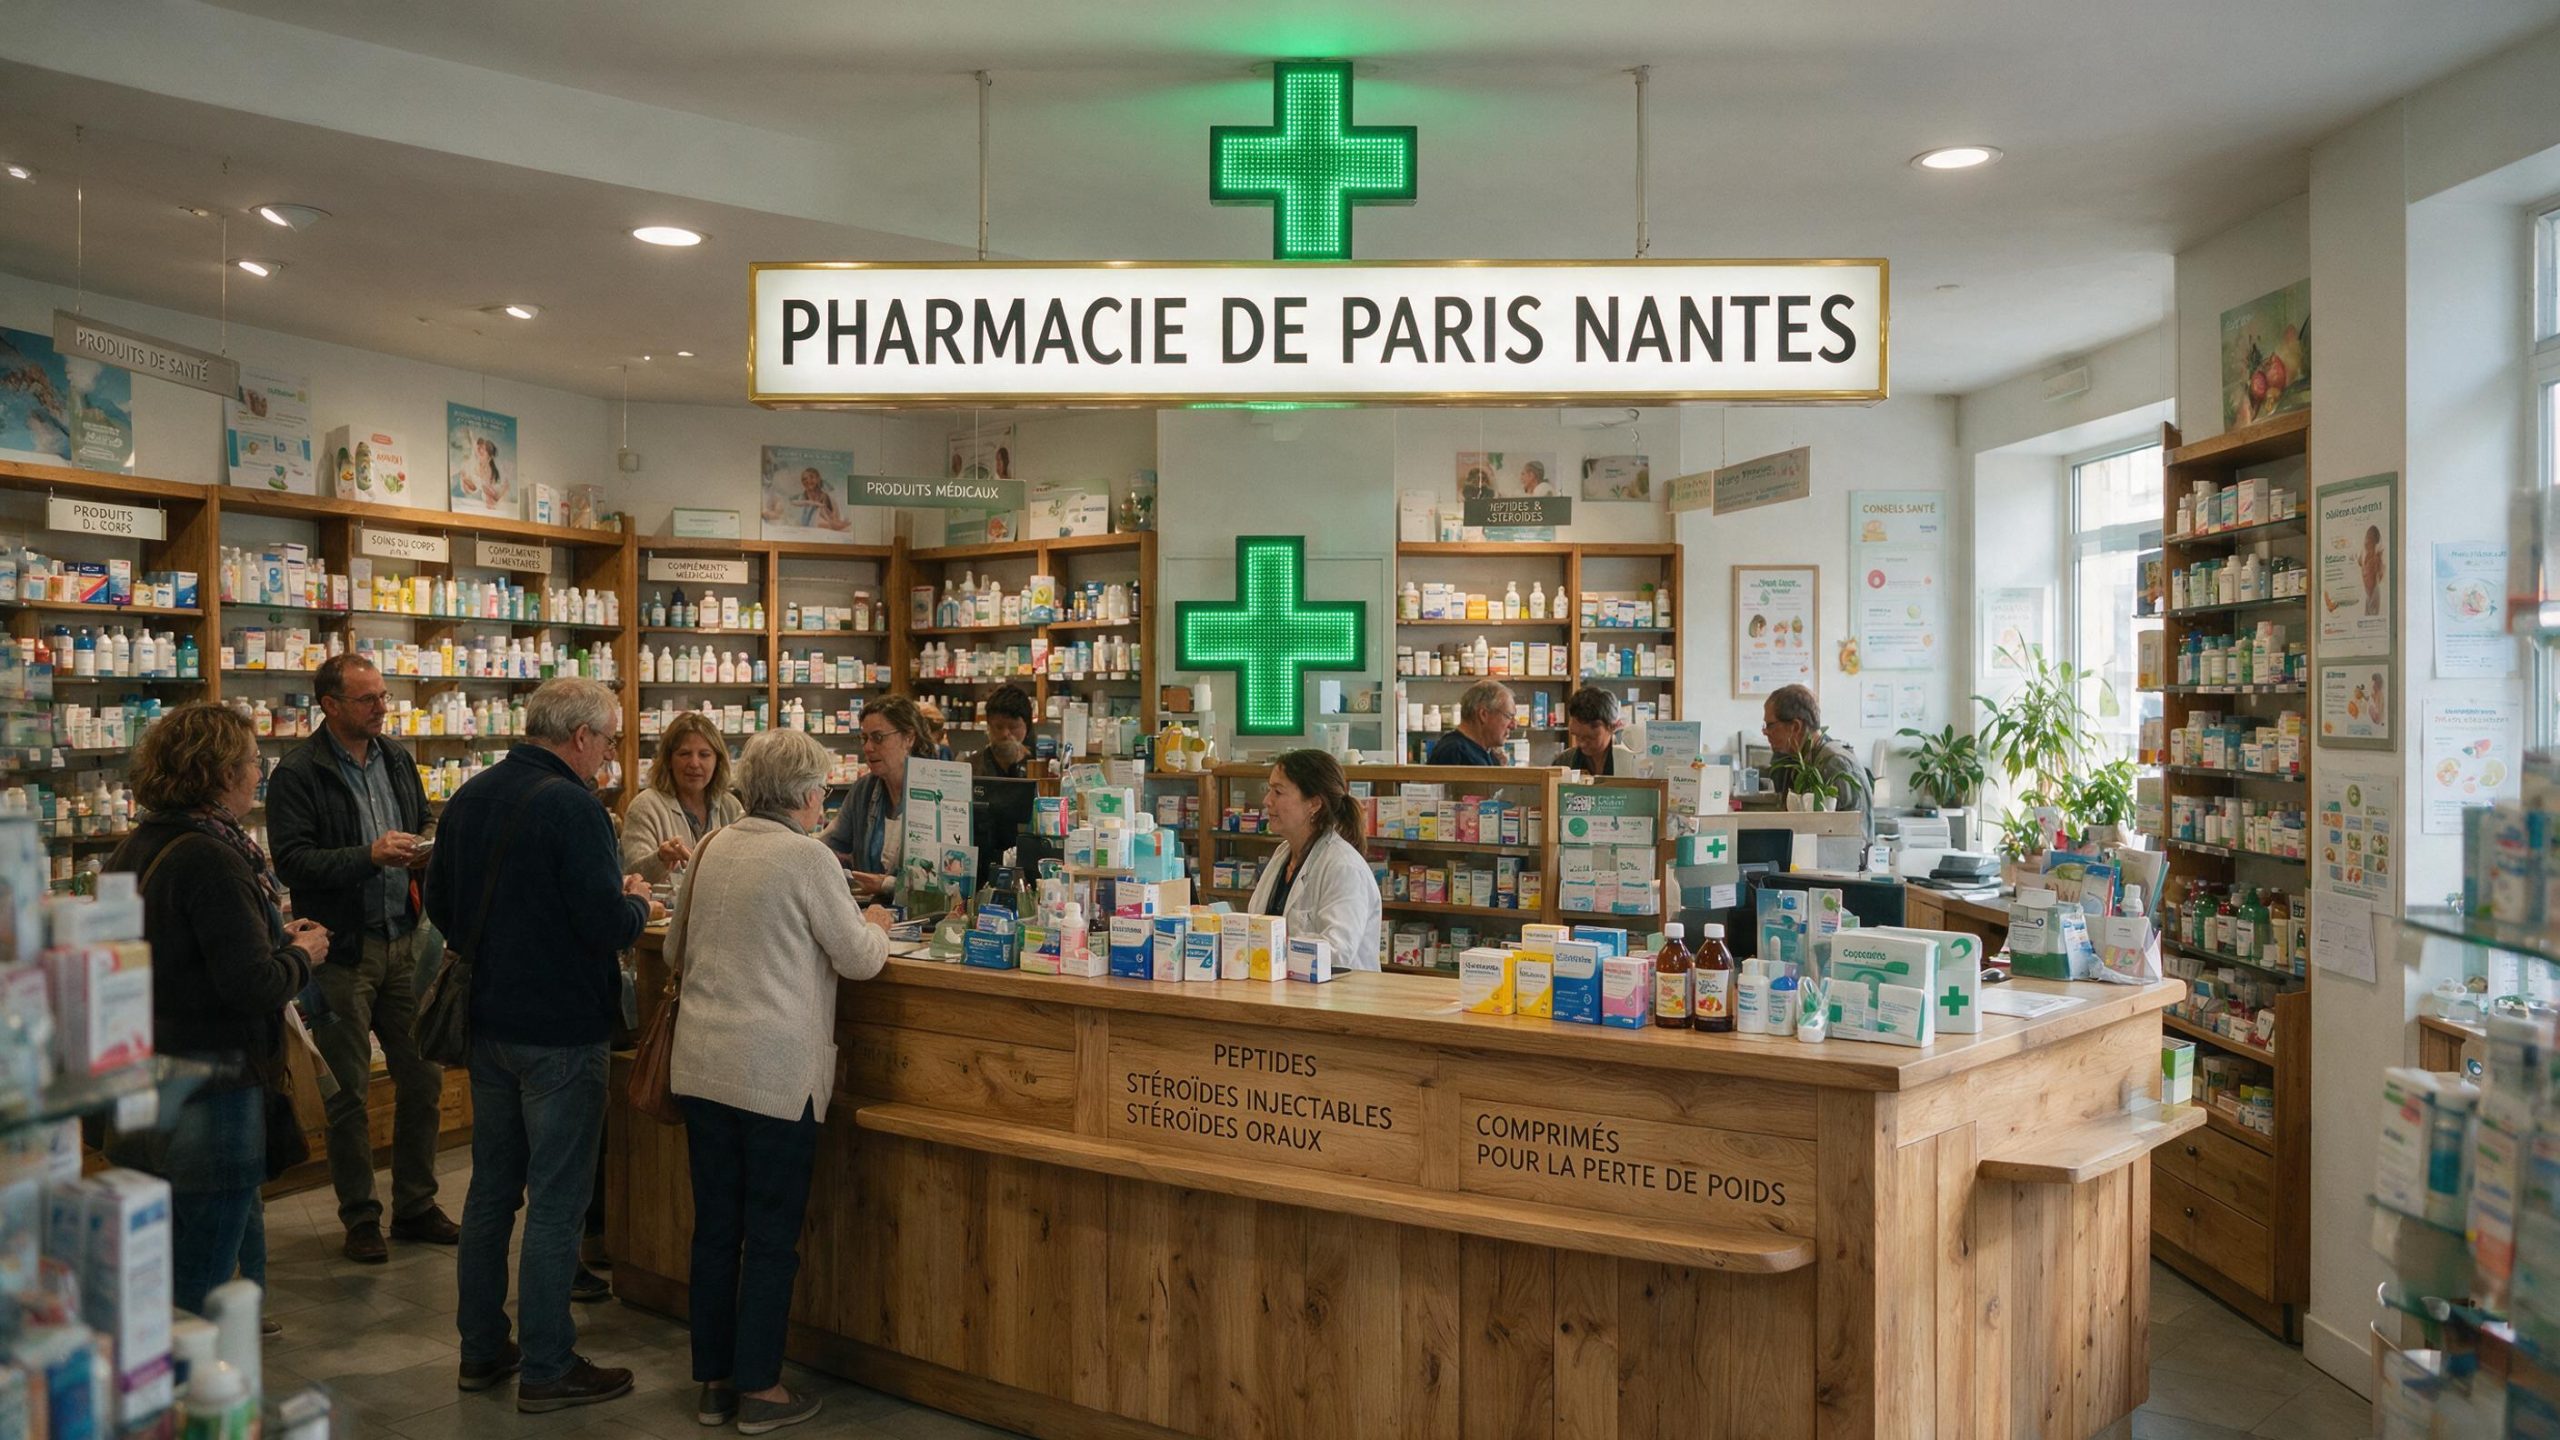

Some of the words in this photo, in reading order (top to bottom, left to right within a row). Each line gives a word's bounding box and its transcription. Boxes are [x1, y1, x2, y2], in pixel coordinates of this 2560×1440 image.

[782, 297, 1187, 365] PHARMACIE
[1222, 297, 1308, 364] DE
[1343, 296, 1543, 364] PARIS
[1576, 295, 1856, 364] NANTES
[77, 326, 145, 366] PRODUITS
[150, 351, 165, 370] DE
[169, 358, 208, 383] SANTÉ
[866, 481, 931, 497] PRODUITS
[935, 481, 999, 499] MÉDICAUX
[1534, 500, 1542, 511] &
[73, 504, 134, 522] PRODUITS
[371, 535, 396, 547] SOINS
[1213, 1043, 1317, 1078] PEPTIDES
[1126, 1070, 1239, 1108] STÉROÏDES
[1246, 1088, 1393, 1130] INJECTABLES
[1126, 1101, 1238, 1139] STÉROÏDES
[1246, 1120, 1322, 1152] ORAUX
[1476, 1113, 1620, 1154] COMPRIMÉS
[1477, 1143, 1540, 1173] POUR
[1548, 1153, 1576, 1178] LA
[1583, 1157, 1656, 1189] PERTE
[1666, 1168, 1698, 1194] DE
[1708, 1173, 1787, 1206] POIDS
